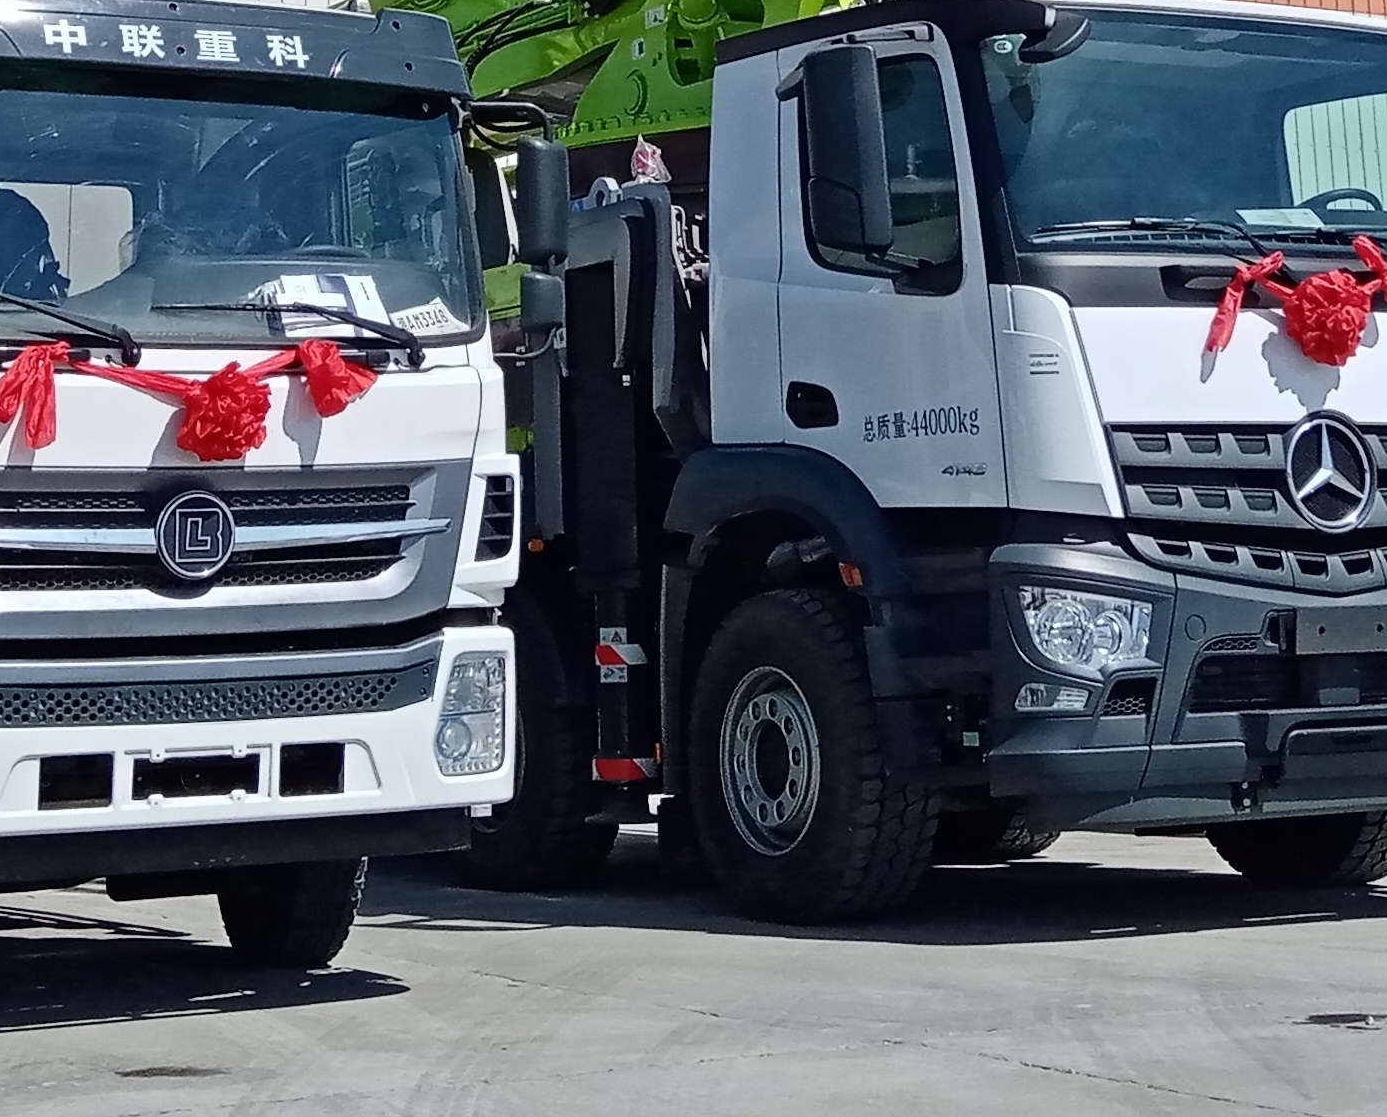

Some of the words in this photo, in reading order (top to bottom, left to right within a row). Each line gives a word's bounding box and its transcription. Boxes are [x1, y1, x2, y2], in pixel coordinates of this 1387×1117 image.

[43, 19, 310, 68] 中联重科
[862, 405, 980, 443] 总质量:44000kg
